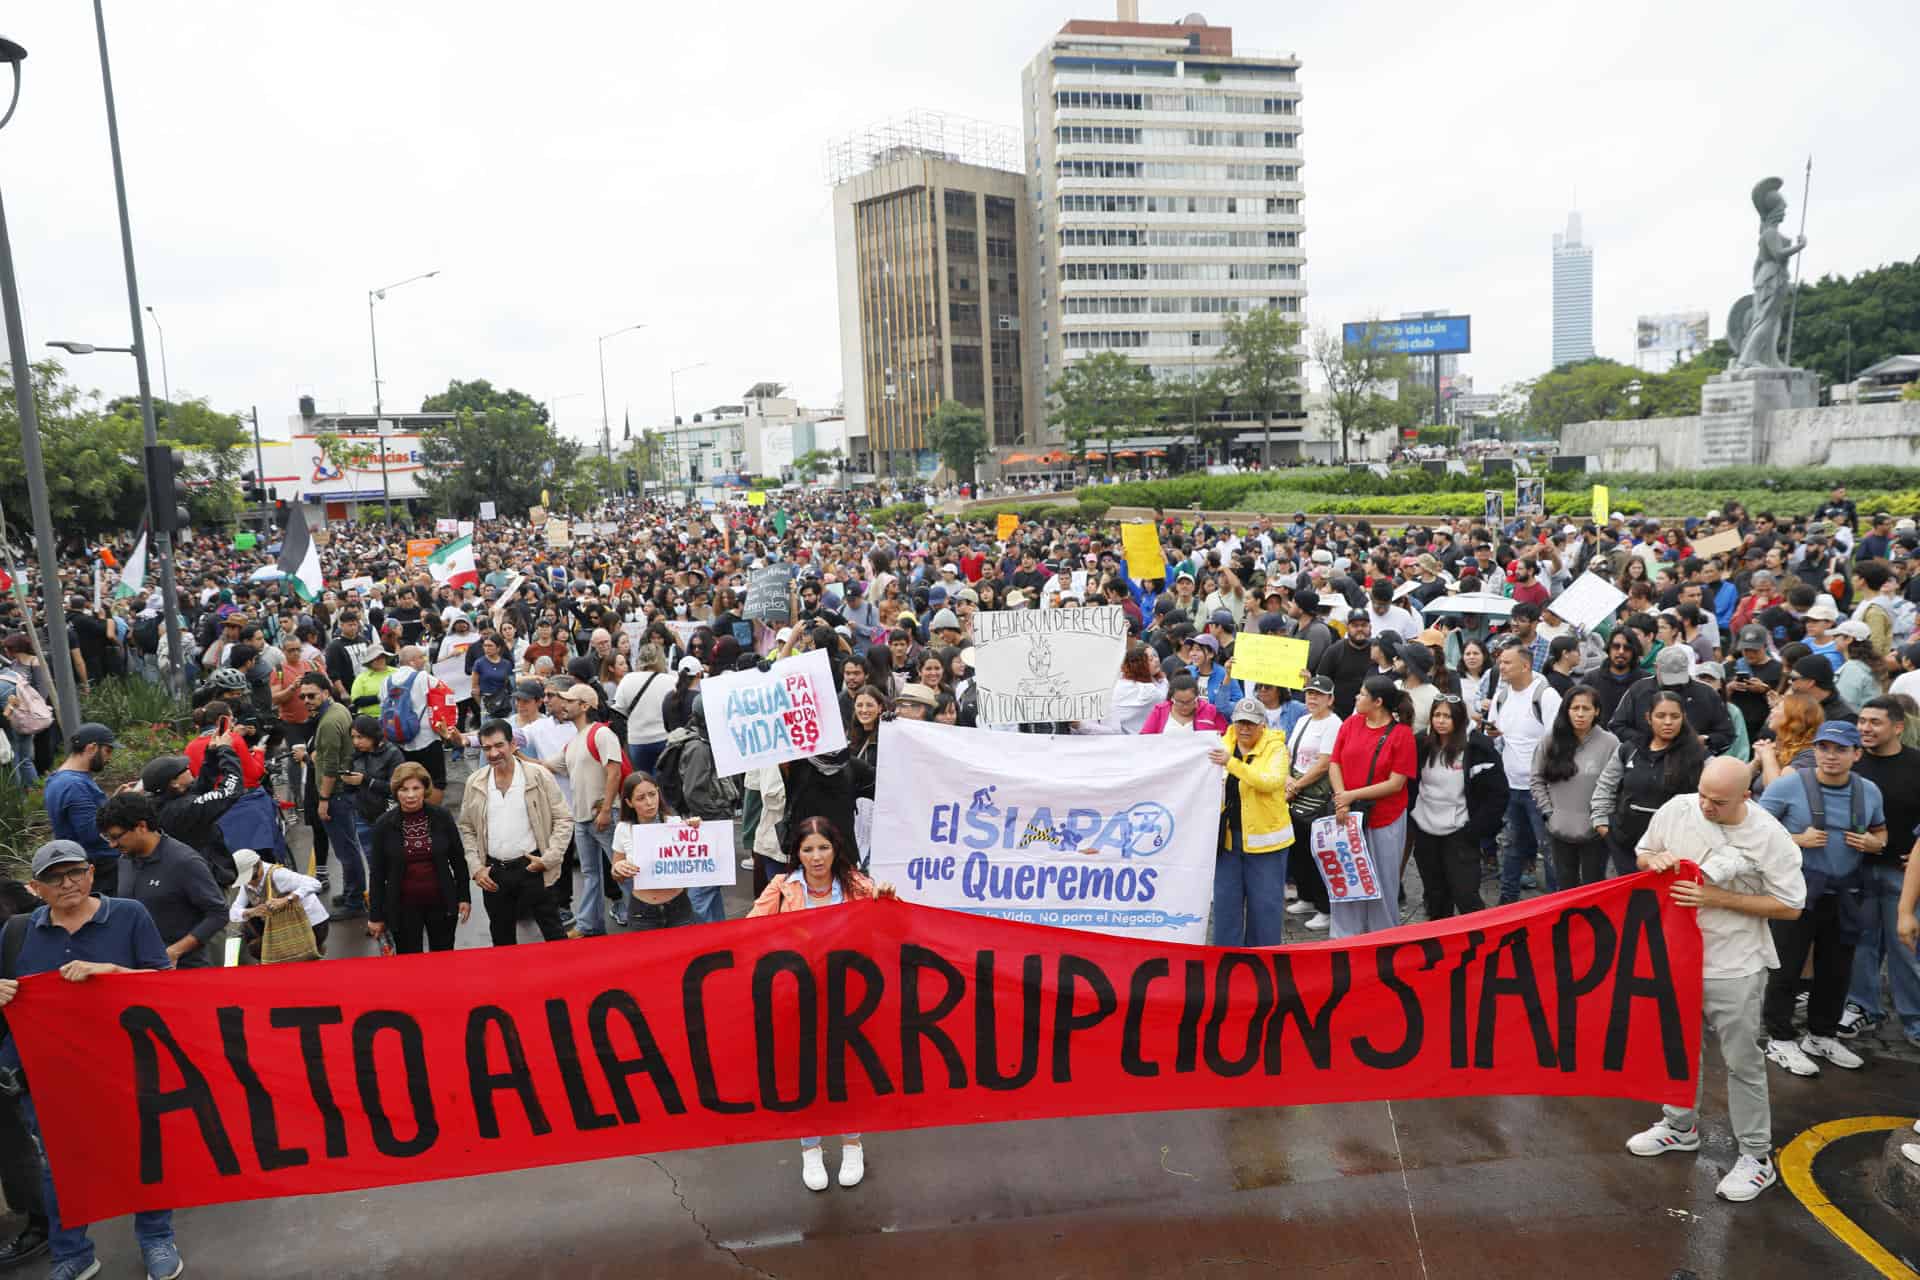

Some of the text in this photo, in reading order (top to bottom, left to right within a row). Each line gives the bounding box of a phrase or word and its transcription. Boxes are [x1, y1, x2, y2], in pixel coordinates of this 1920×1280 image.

[1053, 607, 1124, 636] DERECHO
[785, 674, 808, 691] PA
[727, 682, 791, 720] AGUA
[791, 691, 813, 707] LA
[731, 717, 791, 757] VIDA
[679, 829, 699, 842] NO
[930, 802, 1131, 858] El SIAPA
[659, 845, 708, 858] INVER
[1335, 841, 1359, 887] AGUA
[655, 859, 715, 874] SIONISTAS
[907, 851, 1158, 902] que Queremos
[1040, 912, 1060, 922] NO
[1063, 914, 1092, 925] para
[1096, 912, 1108, 922] el
[1112, 913, 1164, 925] Negocio
[120, 889, 1690, 1184] ALTO A LA CORRUPCION SIAPA
